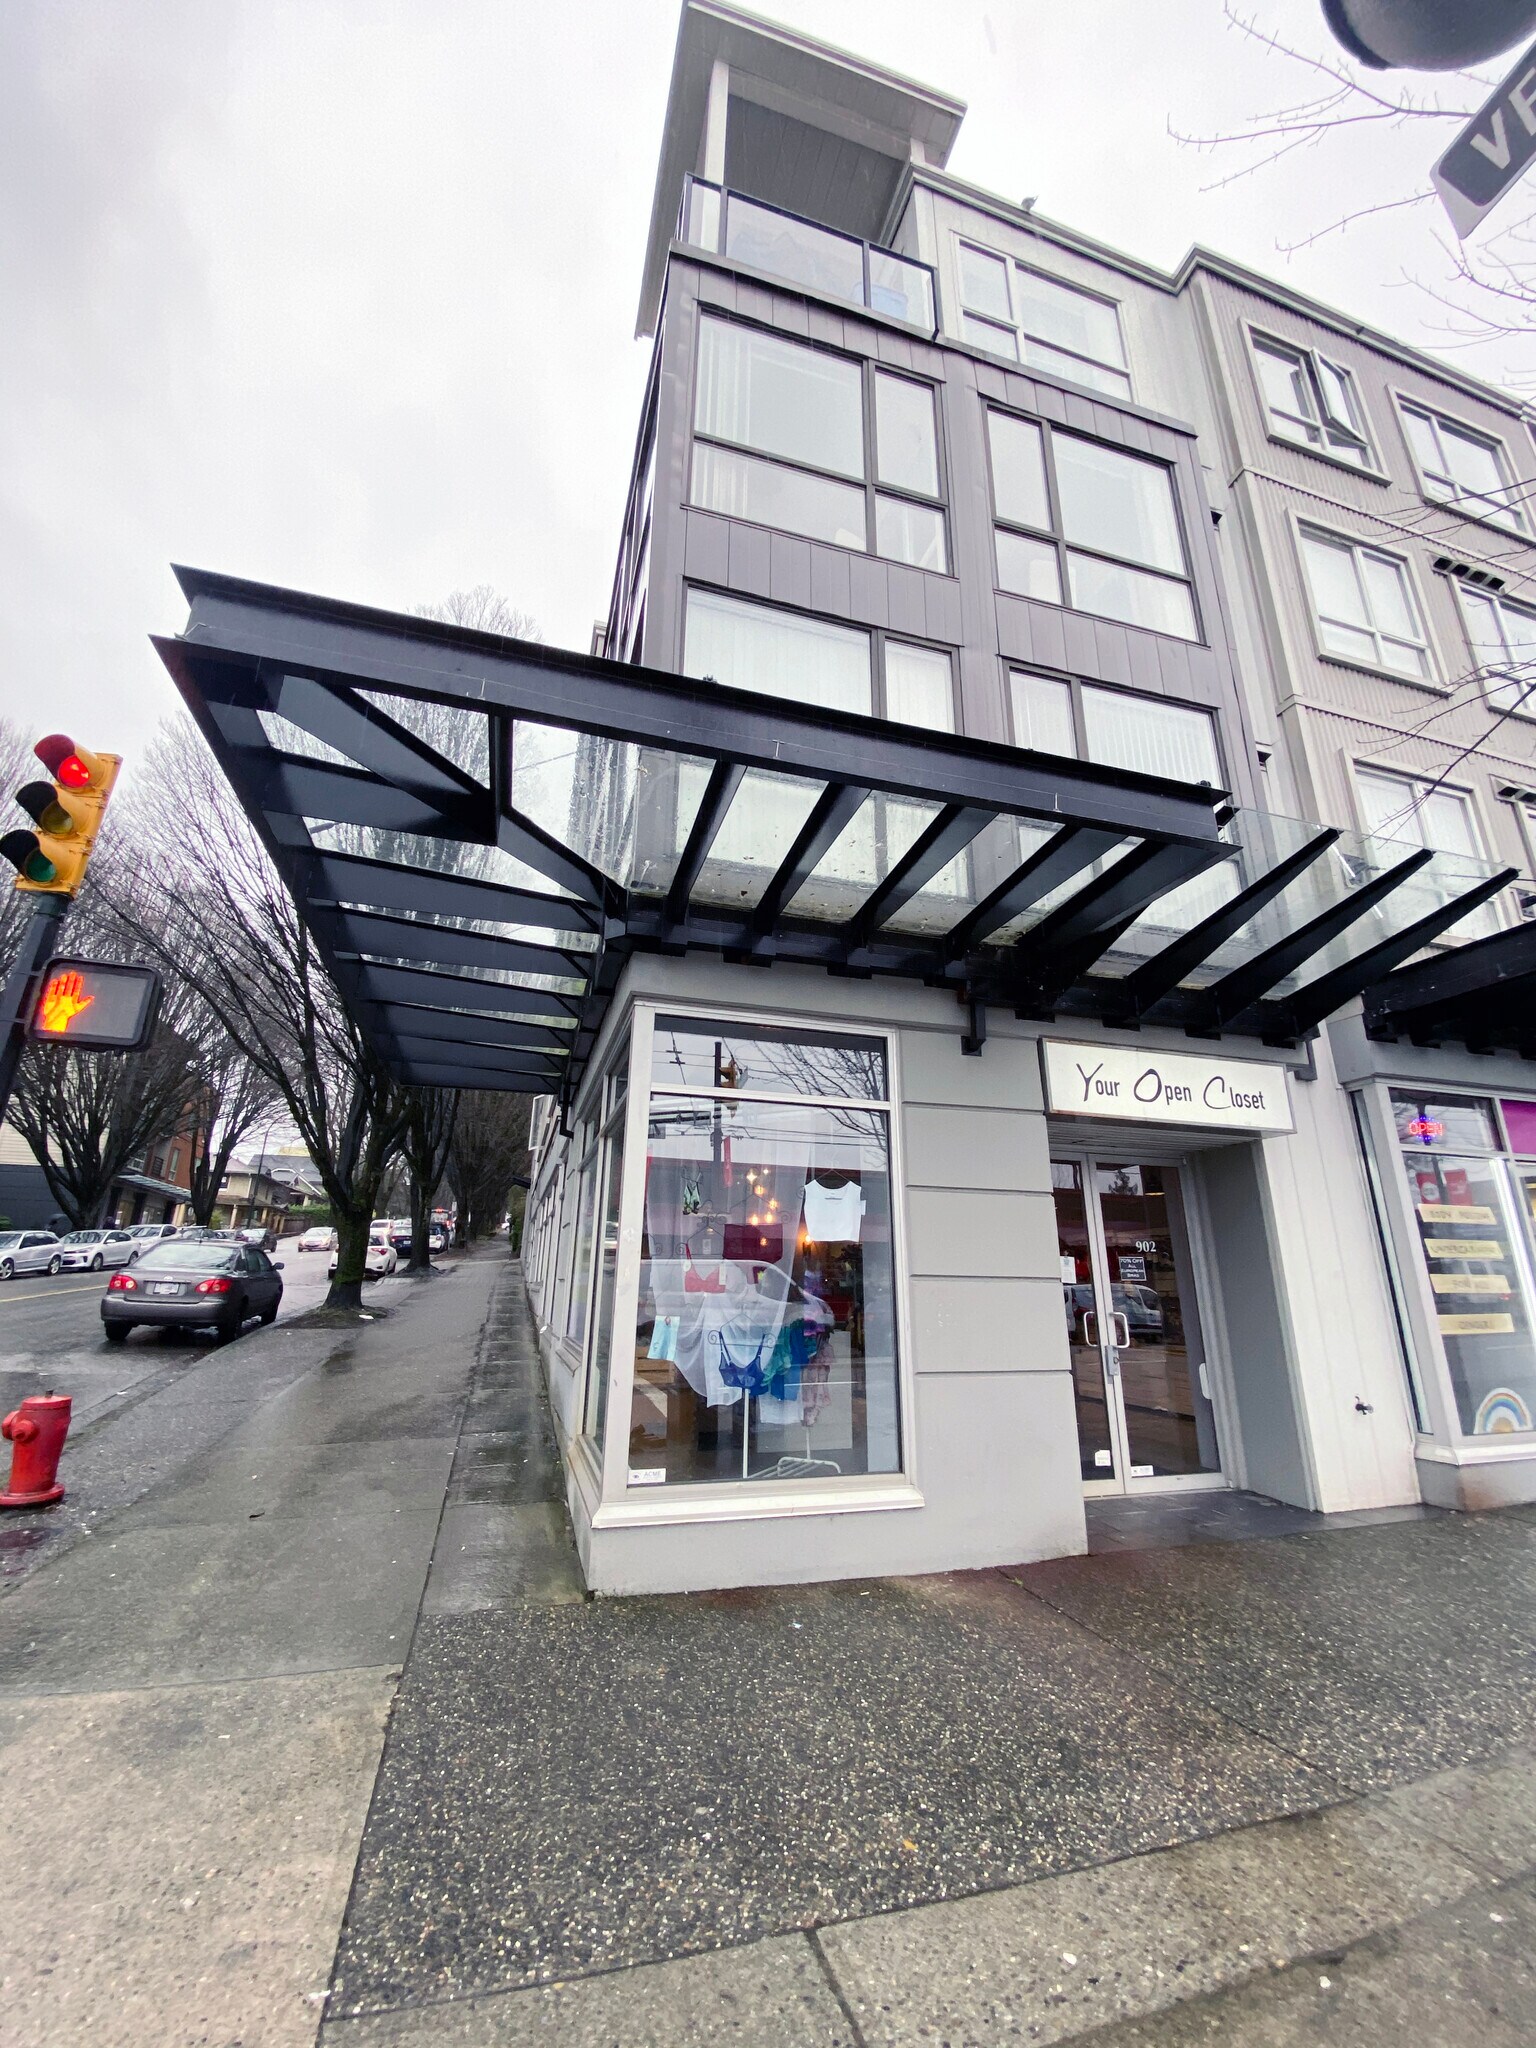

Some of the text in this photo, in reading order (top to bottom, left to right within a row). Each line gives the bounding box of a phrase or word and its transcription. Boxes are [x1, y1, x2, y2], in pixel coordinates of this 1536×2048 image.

[1076, 1062, 1266, 1110] Your Open Closet
[1408, 1122, 1443, 1136] OPEN
[1135, 1240, 1156, 1252] 902
